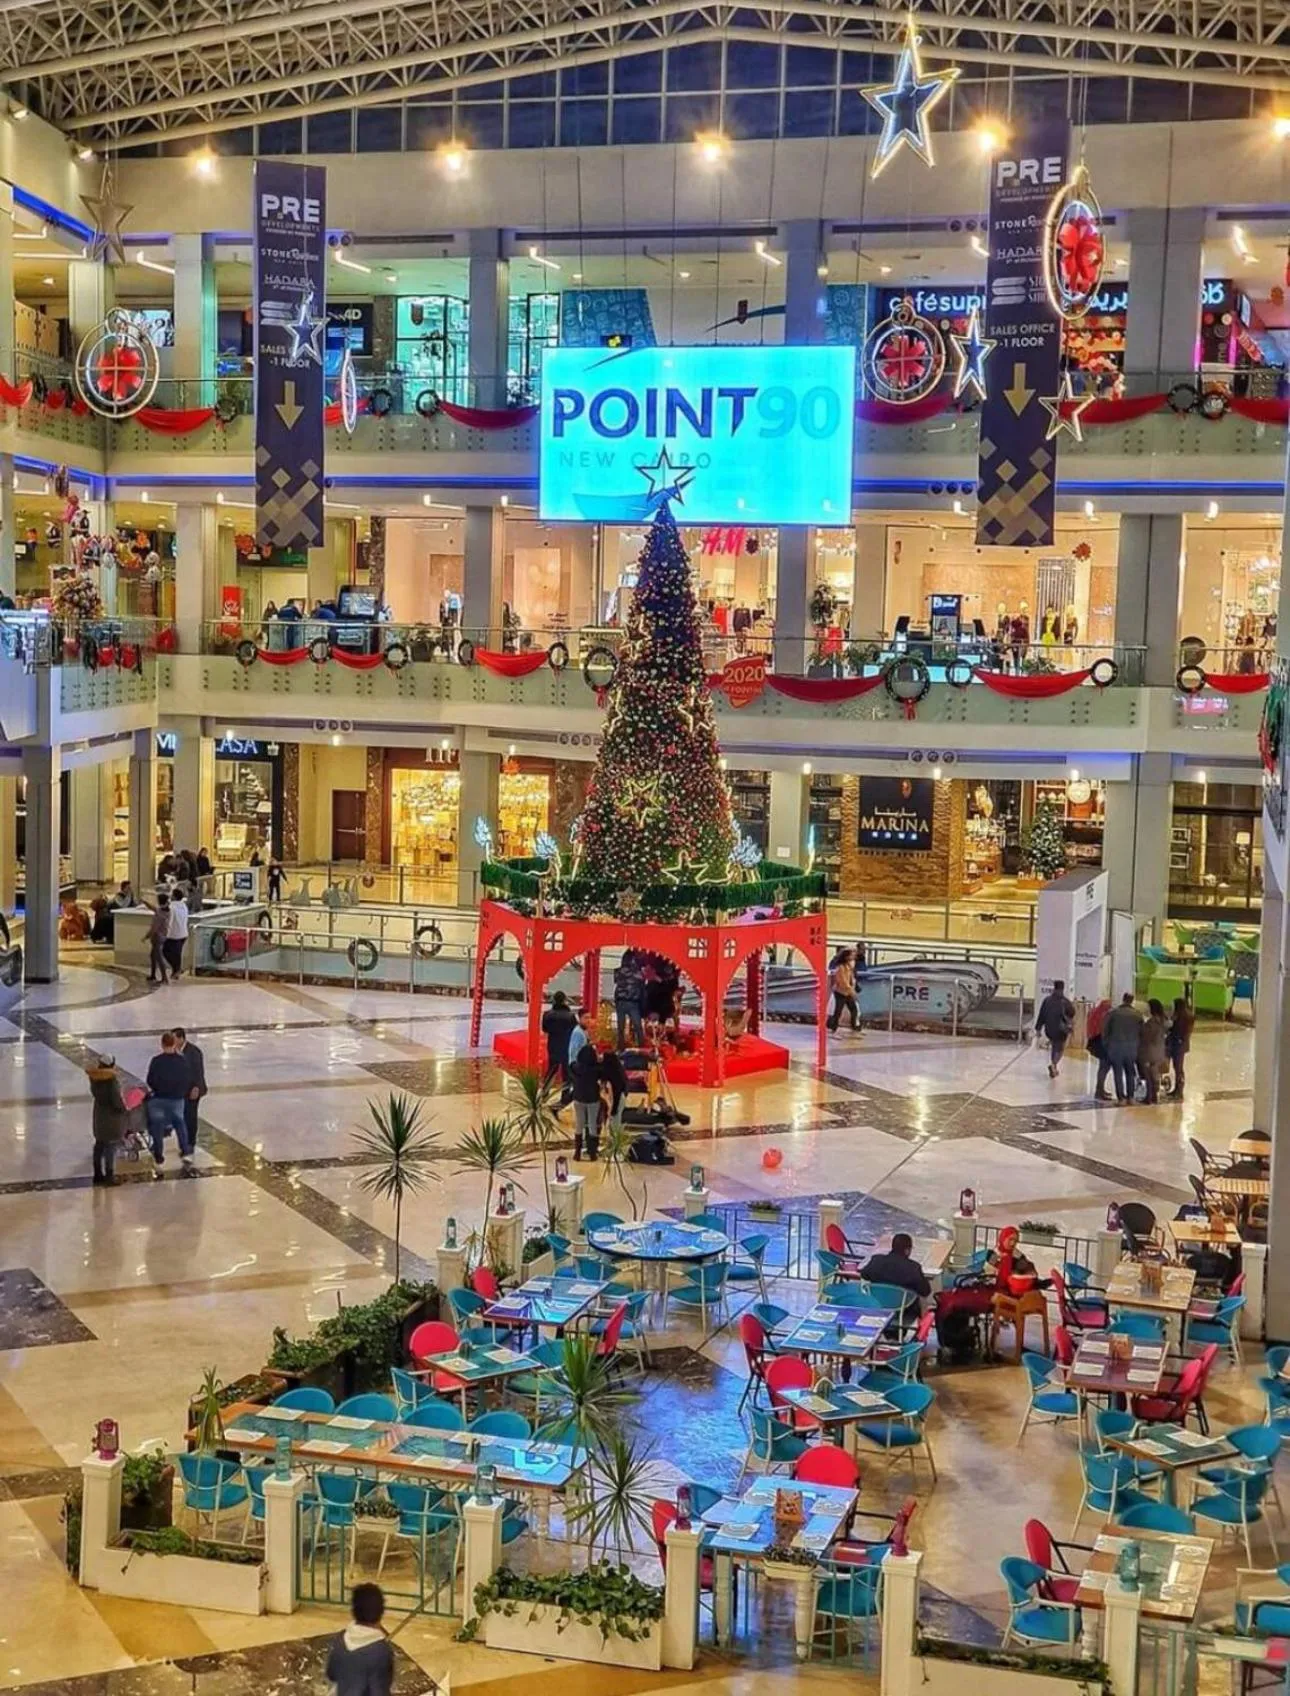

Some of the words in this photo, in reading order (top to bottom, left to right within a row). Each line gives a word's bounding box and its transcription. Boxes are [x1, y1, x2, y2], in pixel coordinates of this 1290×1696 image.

[997, 156, 1061, 188] PRE
[261, 193, 320, 223] PRE
[989, 325, 1017, 336] SALES
[1020, 323, 1056, 334] OFFICE
[1011, 336, 1045, 348] FLOOR
[552, 385, 841, 440] POINT90
[559, 451, 616, 469] NEW
[723, 665, 766, 685] 2020
[215, 737, 259, 755] ASA
[861, 815, 930, 833] MARINA
[892, 985, 930, 1001] PRE
